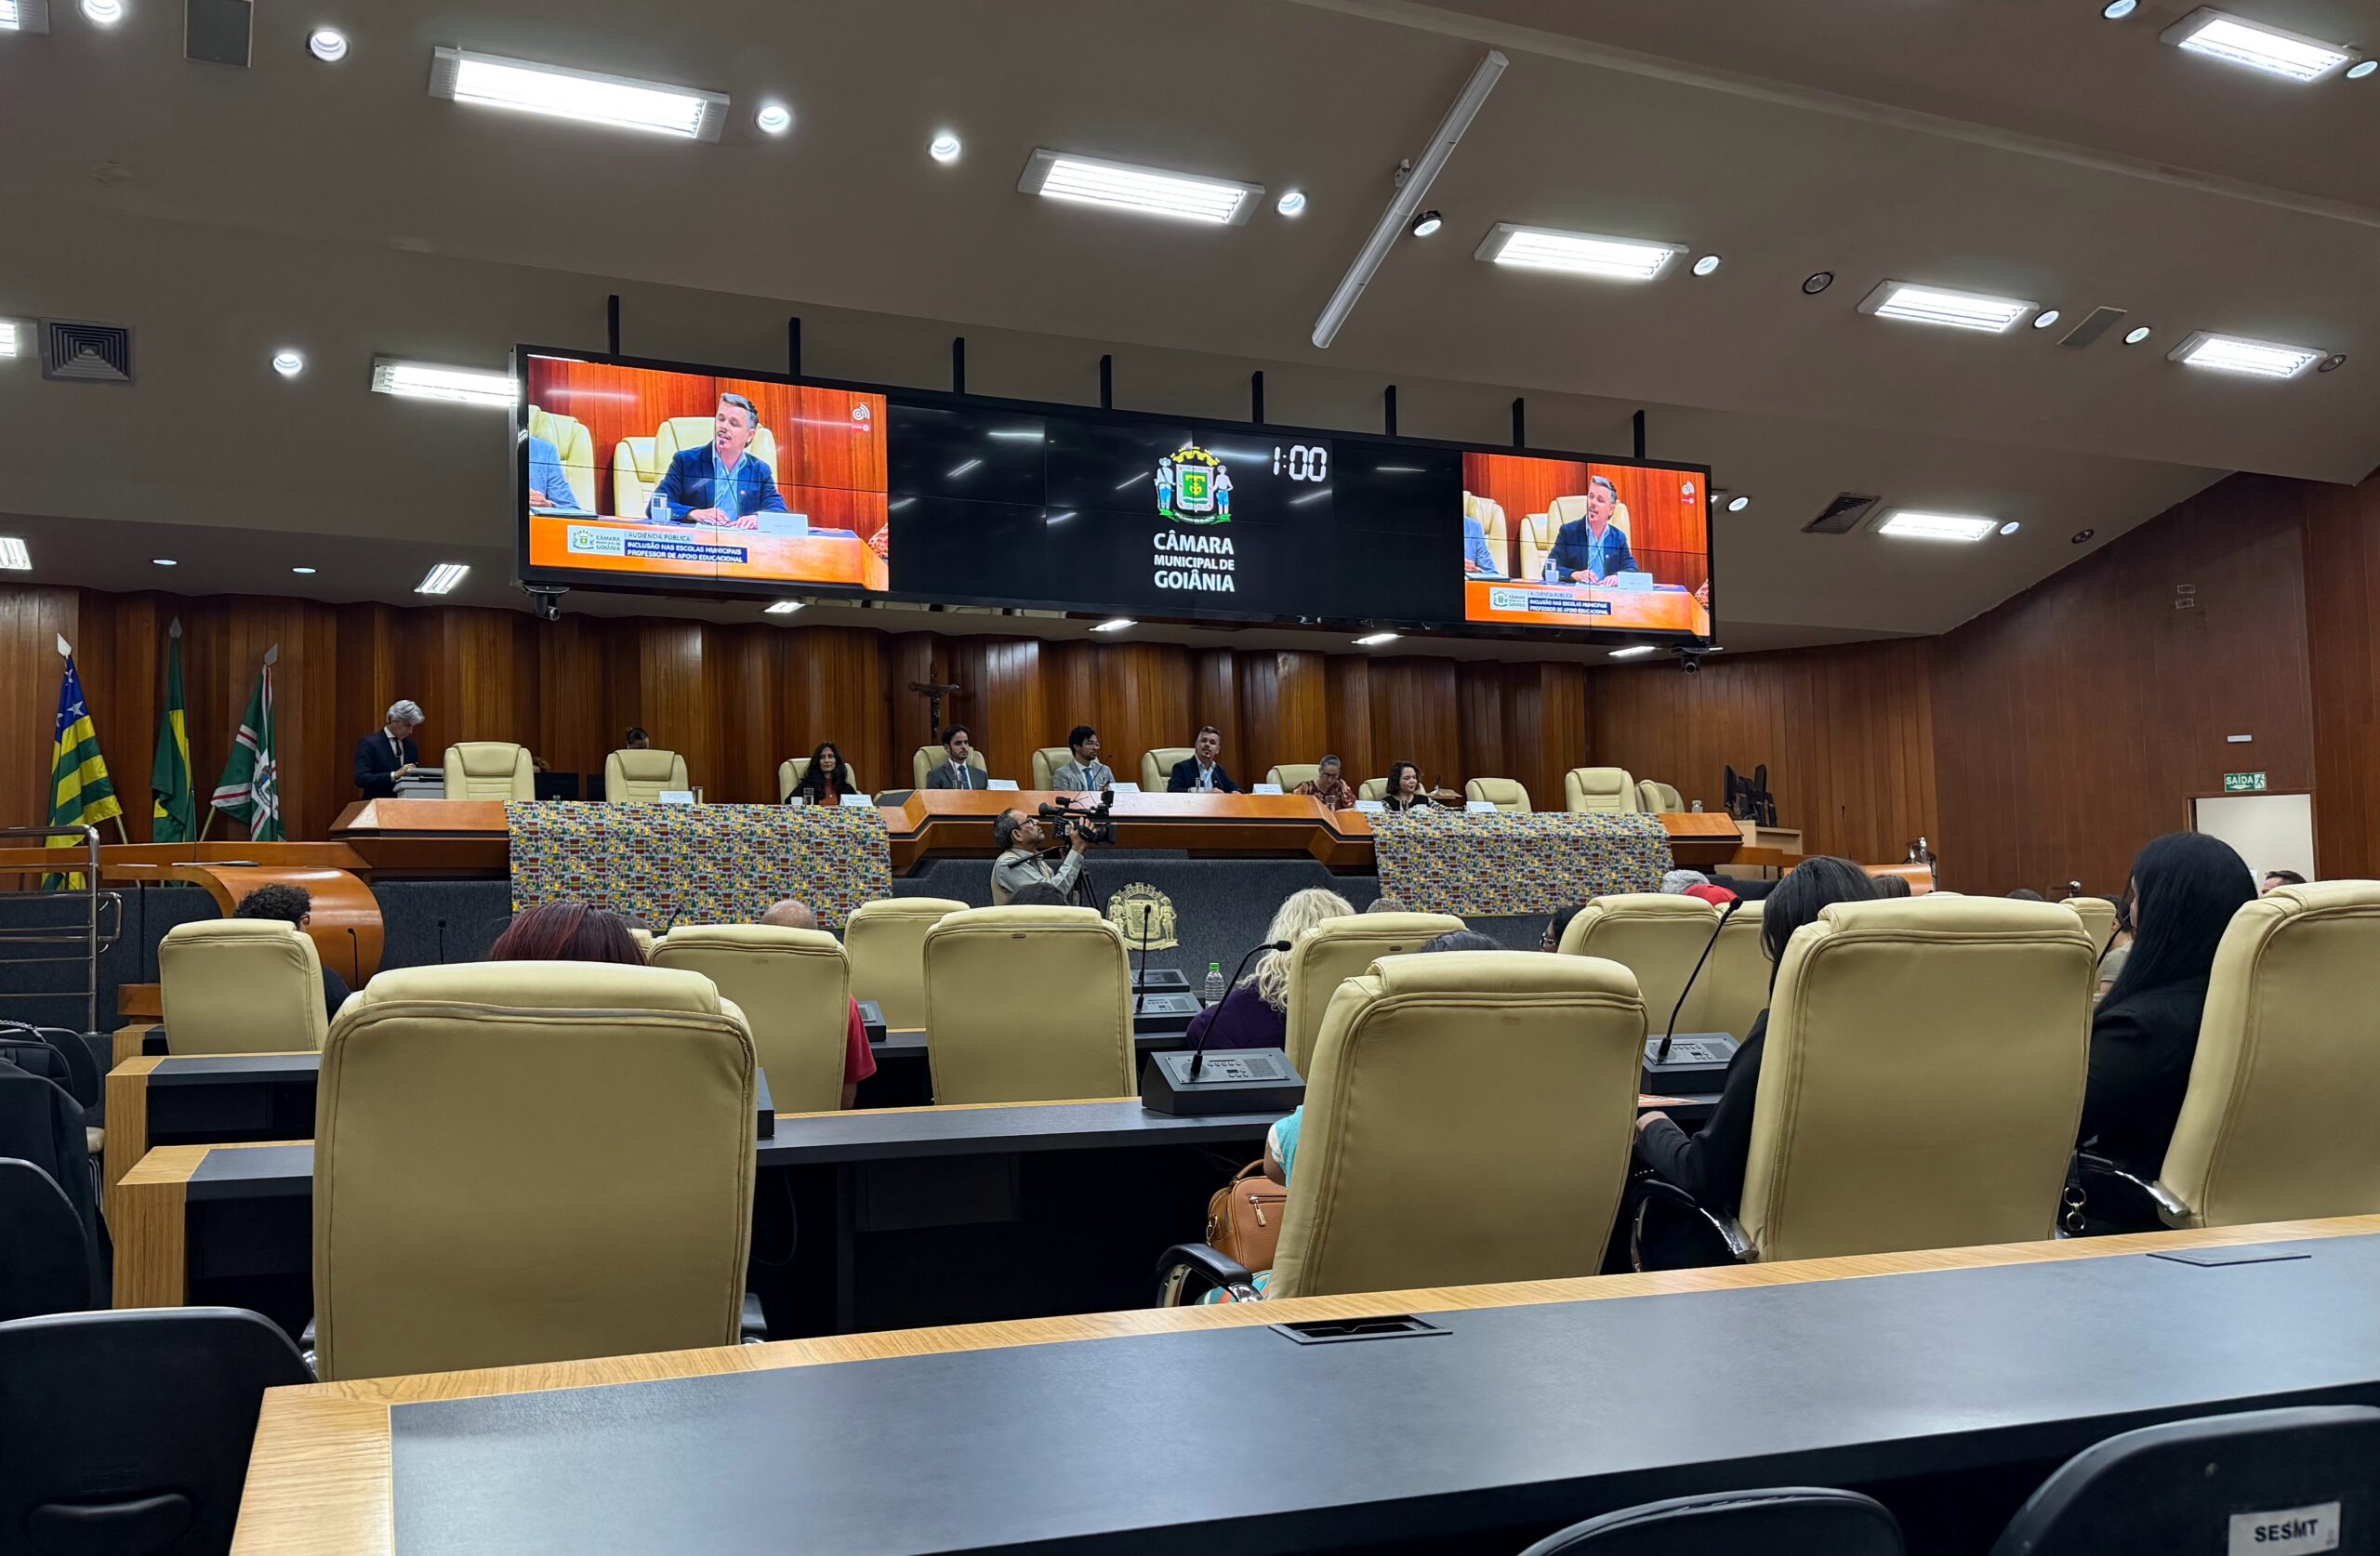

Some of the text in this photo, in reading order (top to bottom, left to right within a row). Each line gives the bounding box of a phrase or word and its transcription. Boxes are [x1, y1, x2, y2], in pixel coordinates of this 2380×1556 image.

[1274, 444, 1328, 482] 1:00
[628, 532, 691, 542] AUDIÊNCIA PÚBLICA
[1154, 529, 1235, 555] CÂMARA
[628, 541, 660, 549] INCLUSÃO
[661, 543, 675, 551] NAS
[706, 547, 742, 555] MUNICIPAIS
[628, 549, 667, 558] PROFESSOR
[677, 552, 697, 560] APOIO
[698, 553, 744, 562] EDUCACIONAL
[1154, 555, 1235, 571] MUNICIPAL DE
[1154, 569, 1235, 592] GOIÂNIA
[2226, 774, 2254, 785] SAÍDA
[2254, 1519, 2319, 1543] SESMT
